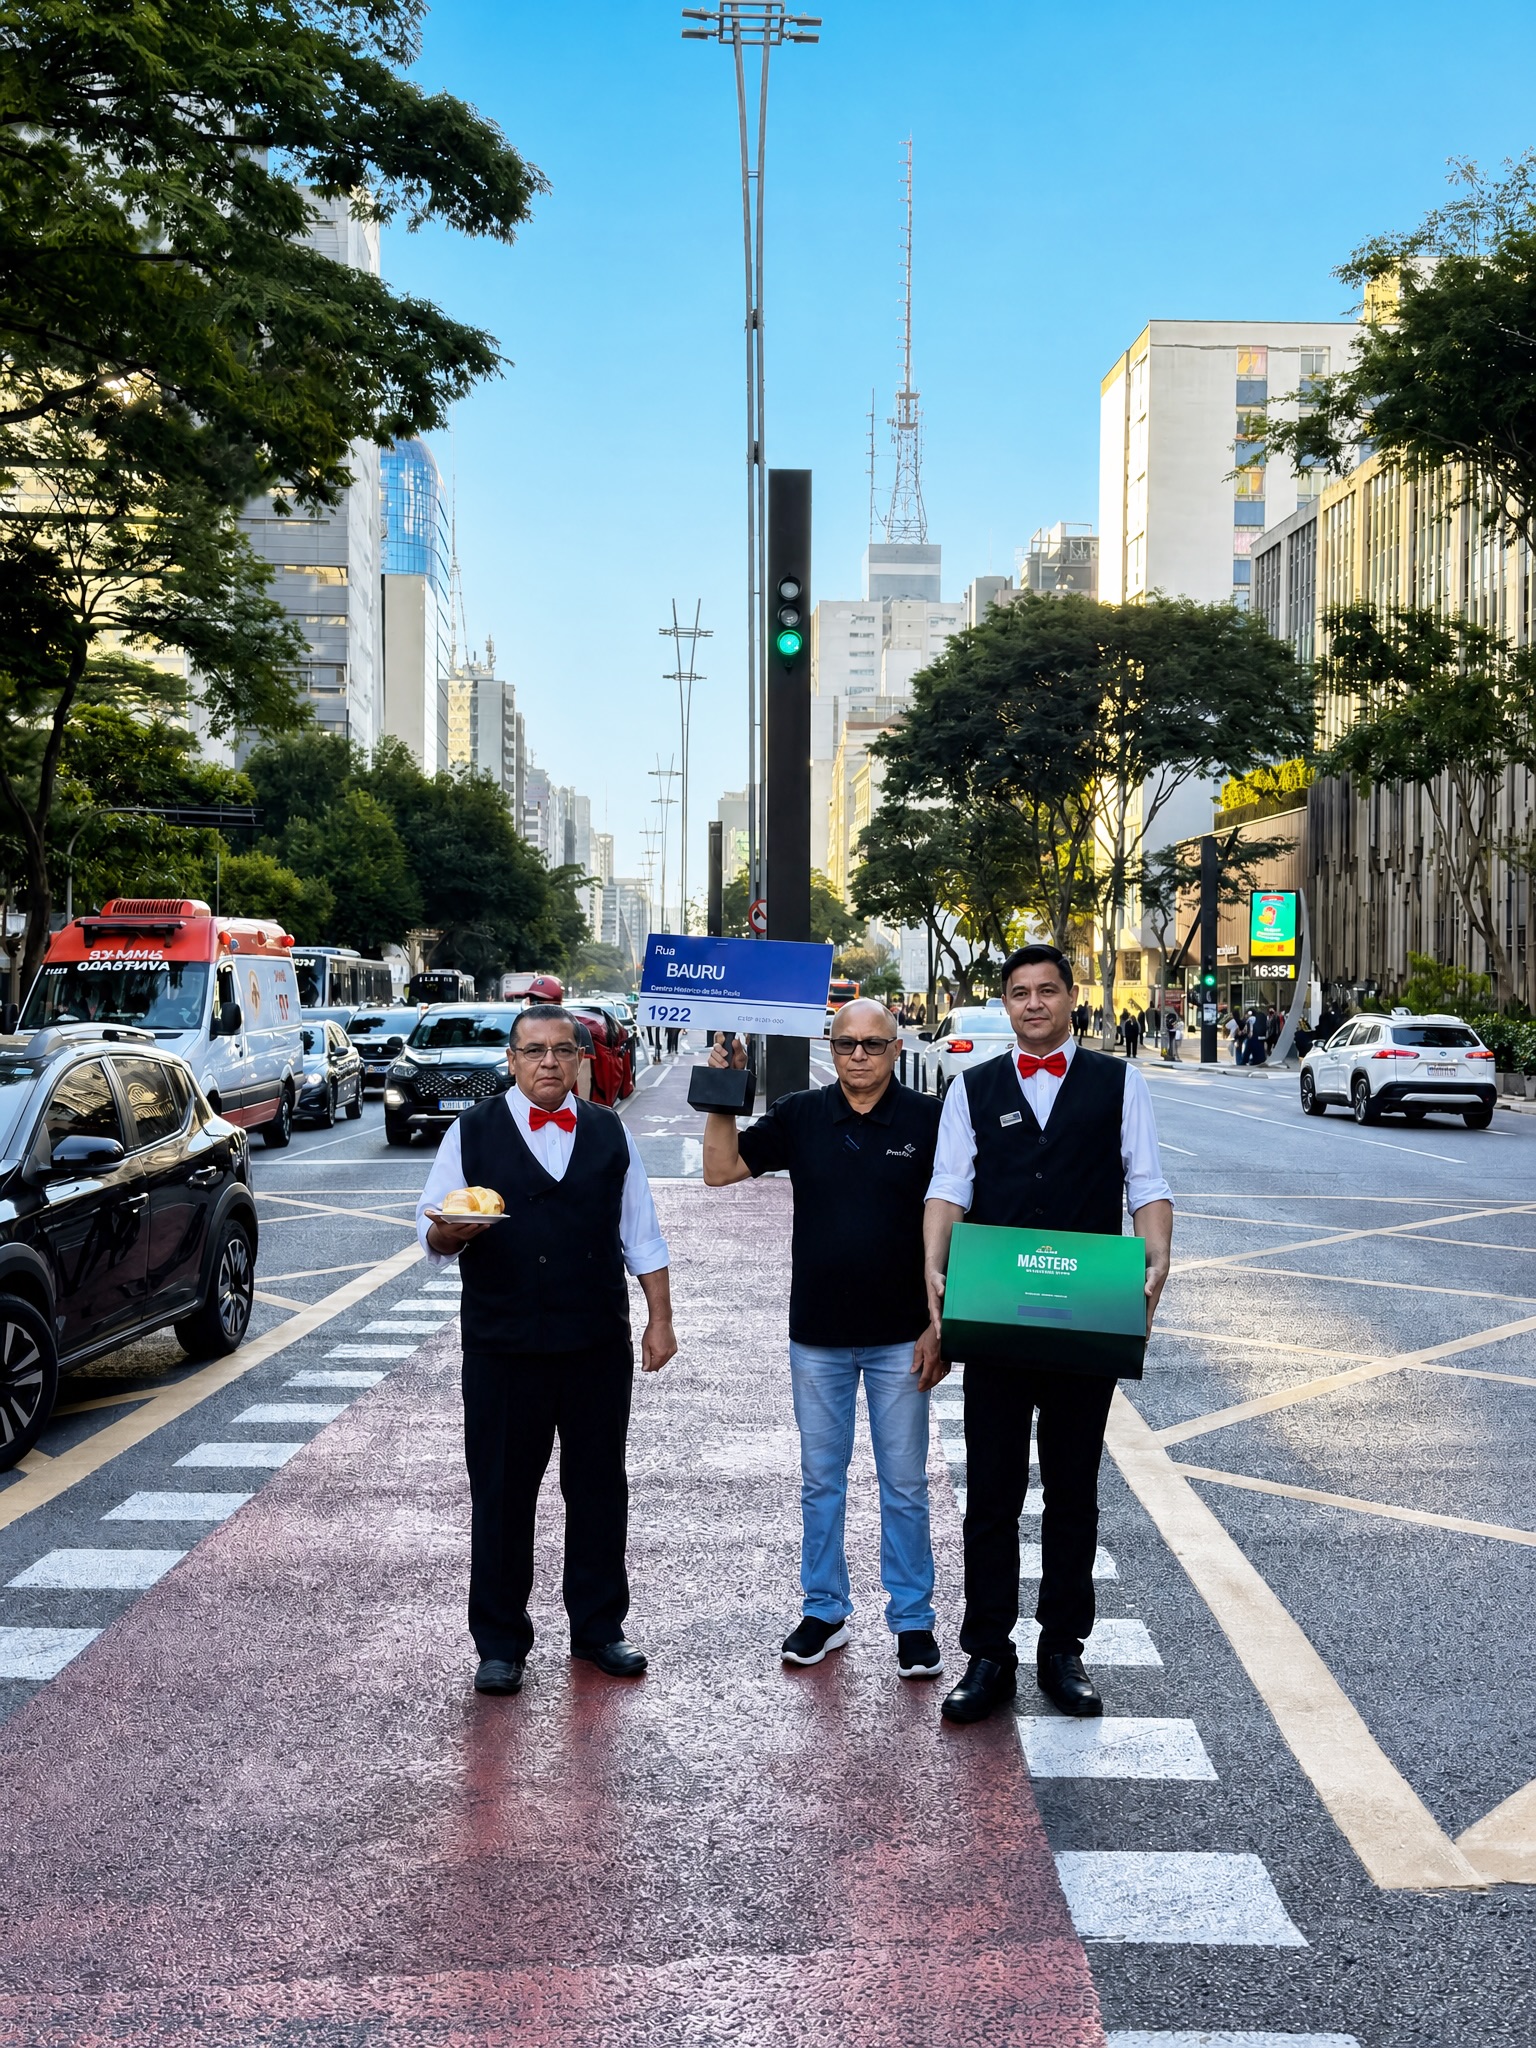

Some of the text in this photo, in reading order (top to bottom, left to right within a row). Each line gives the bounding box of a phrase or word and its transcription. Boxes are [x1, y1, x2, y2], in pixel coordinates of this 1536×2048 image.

[655, 945, 676, 956] Rua
[666, 962, 726, 981] BAURU
[1253, 964, 1287, 978] 16:35
[648, 1005, 692, 1022] 1922
[1017, 1254, 1078, 1272] MASTERS
